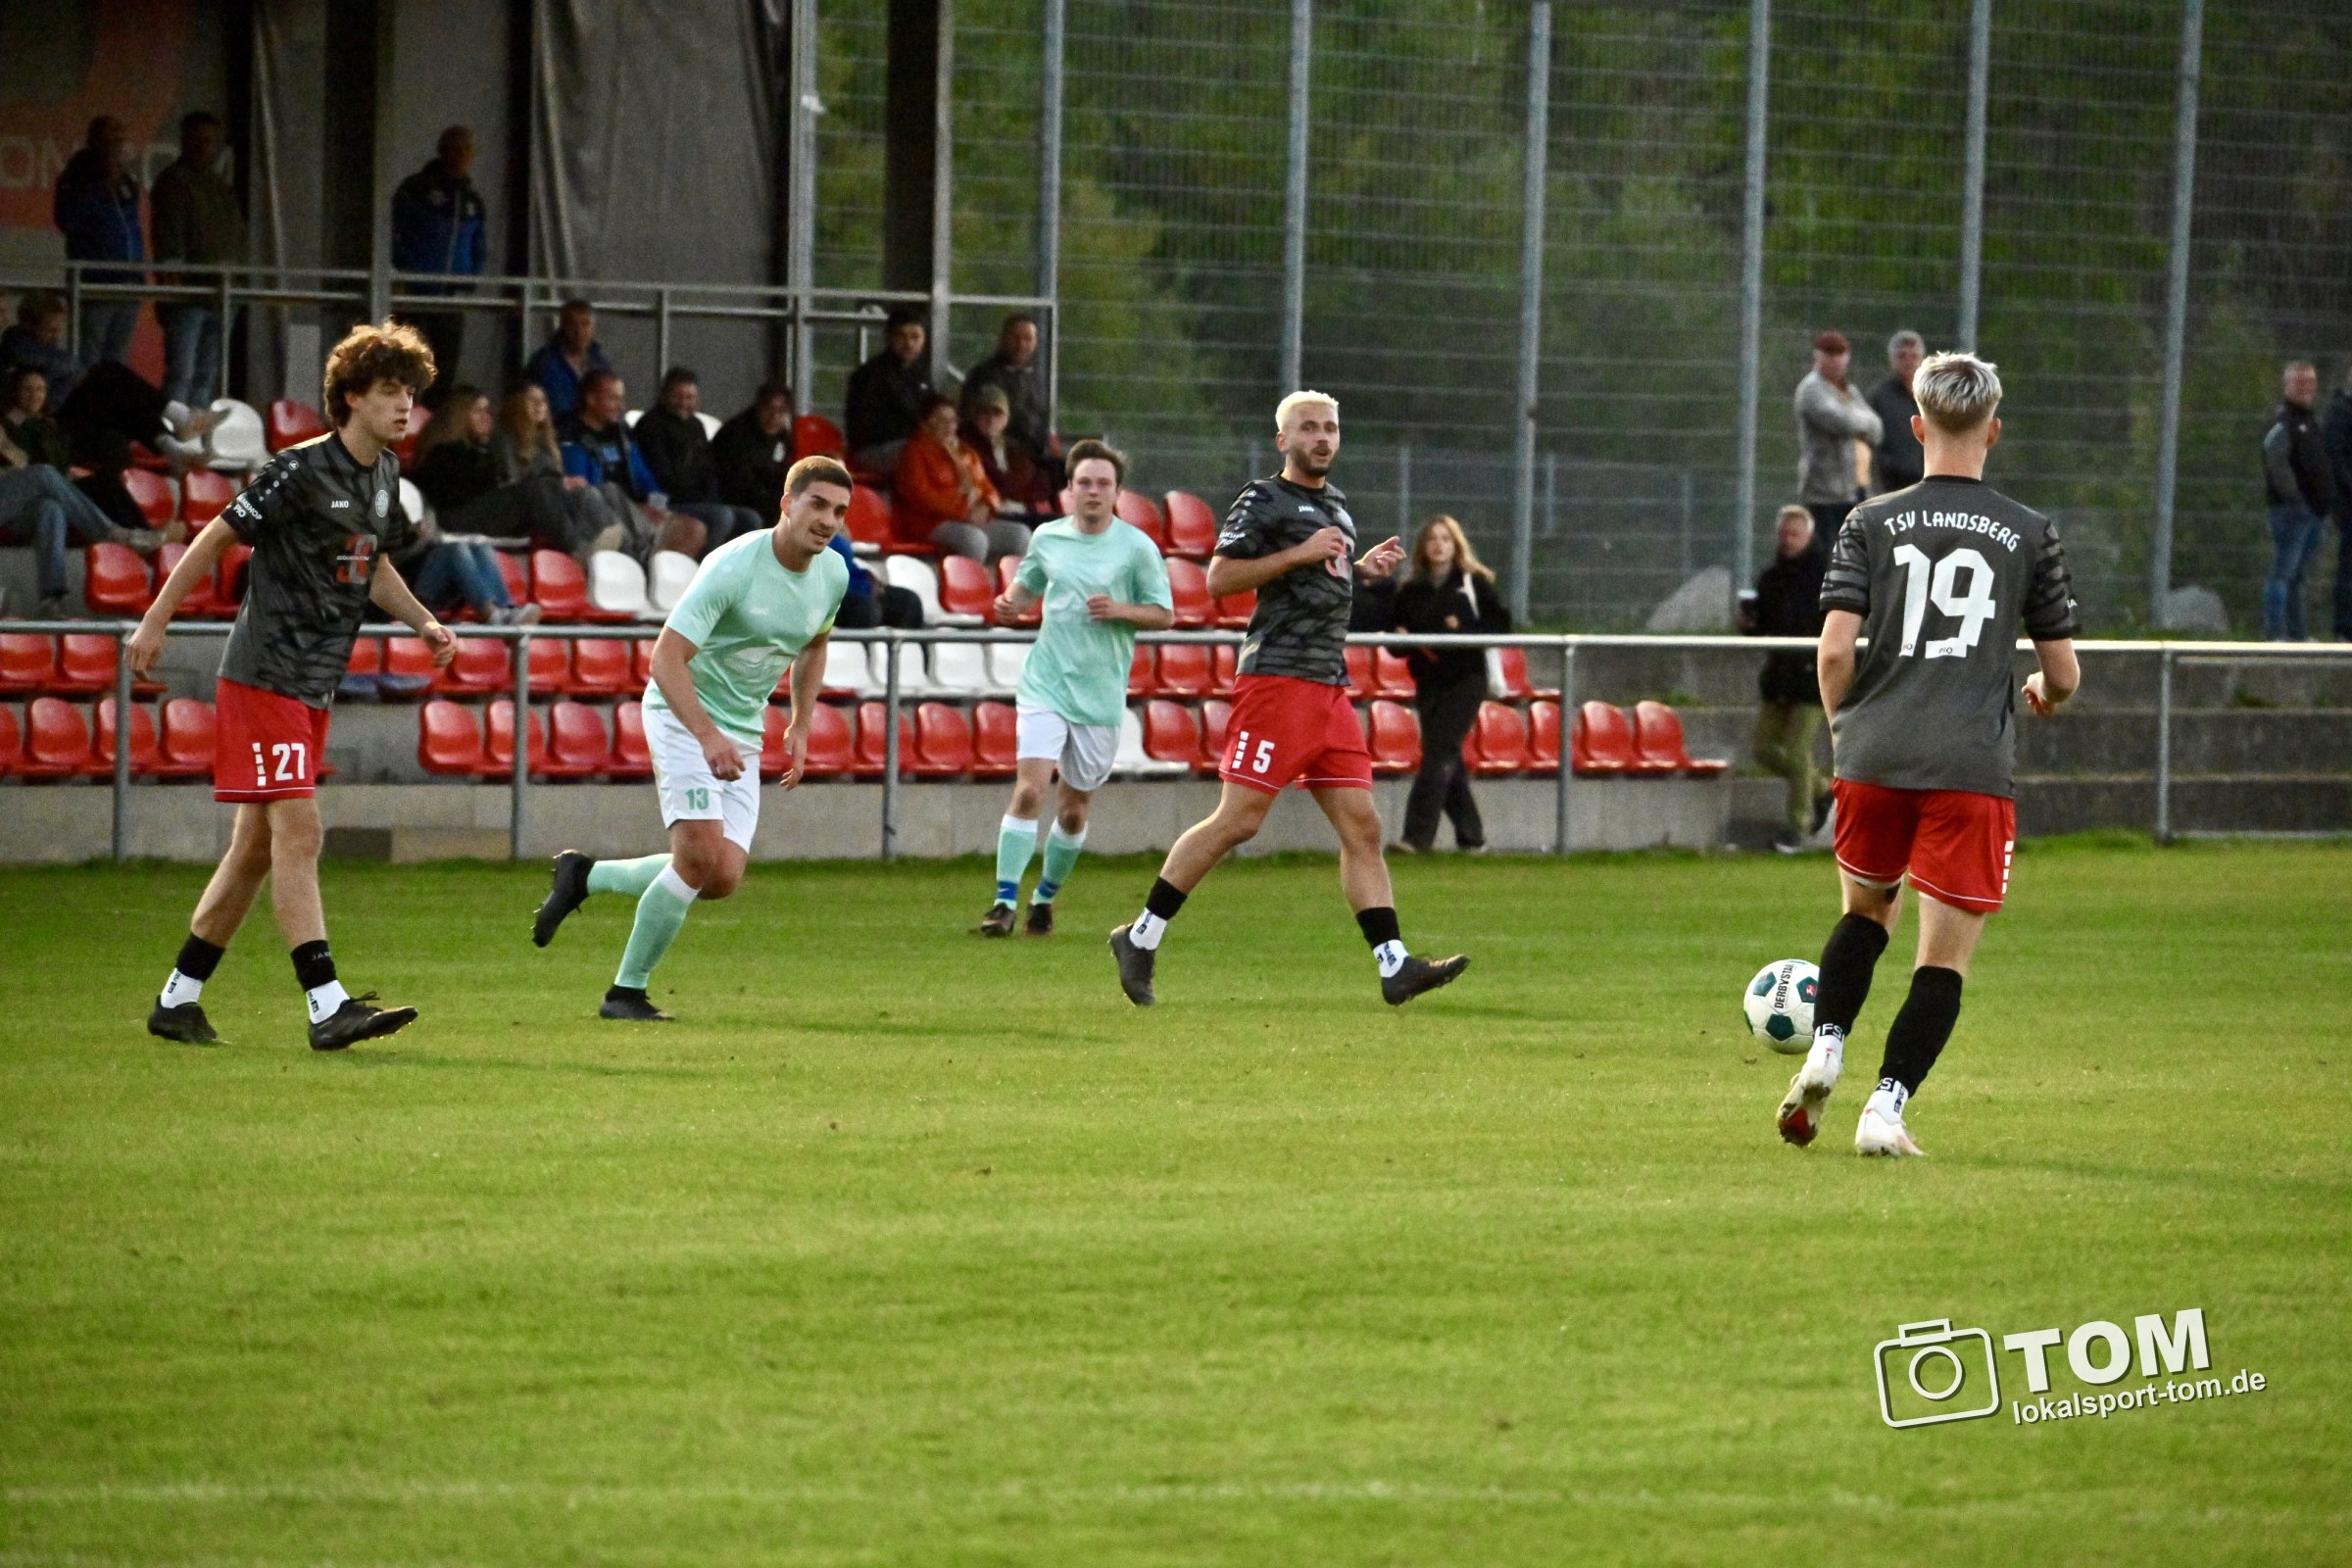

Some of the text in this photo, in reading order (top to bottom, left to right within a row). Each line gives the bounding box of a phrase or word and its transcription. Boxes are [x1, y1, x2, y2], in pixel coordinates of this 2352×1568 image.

[330, 500, 350, 509] JAKO
[1884, 510, 2021, 553] TSV LANDSBERG
[1893, 544, 1996, 660] 19
[271, 742, 306, 782] 27
[1252, 740, 1275, 774] 5
[685, 787, 710, 811] 13
